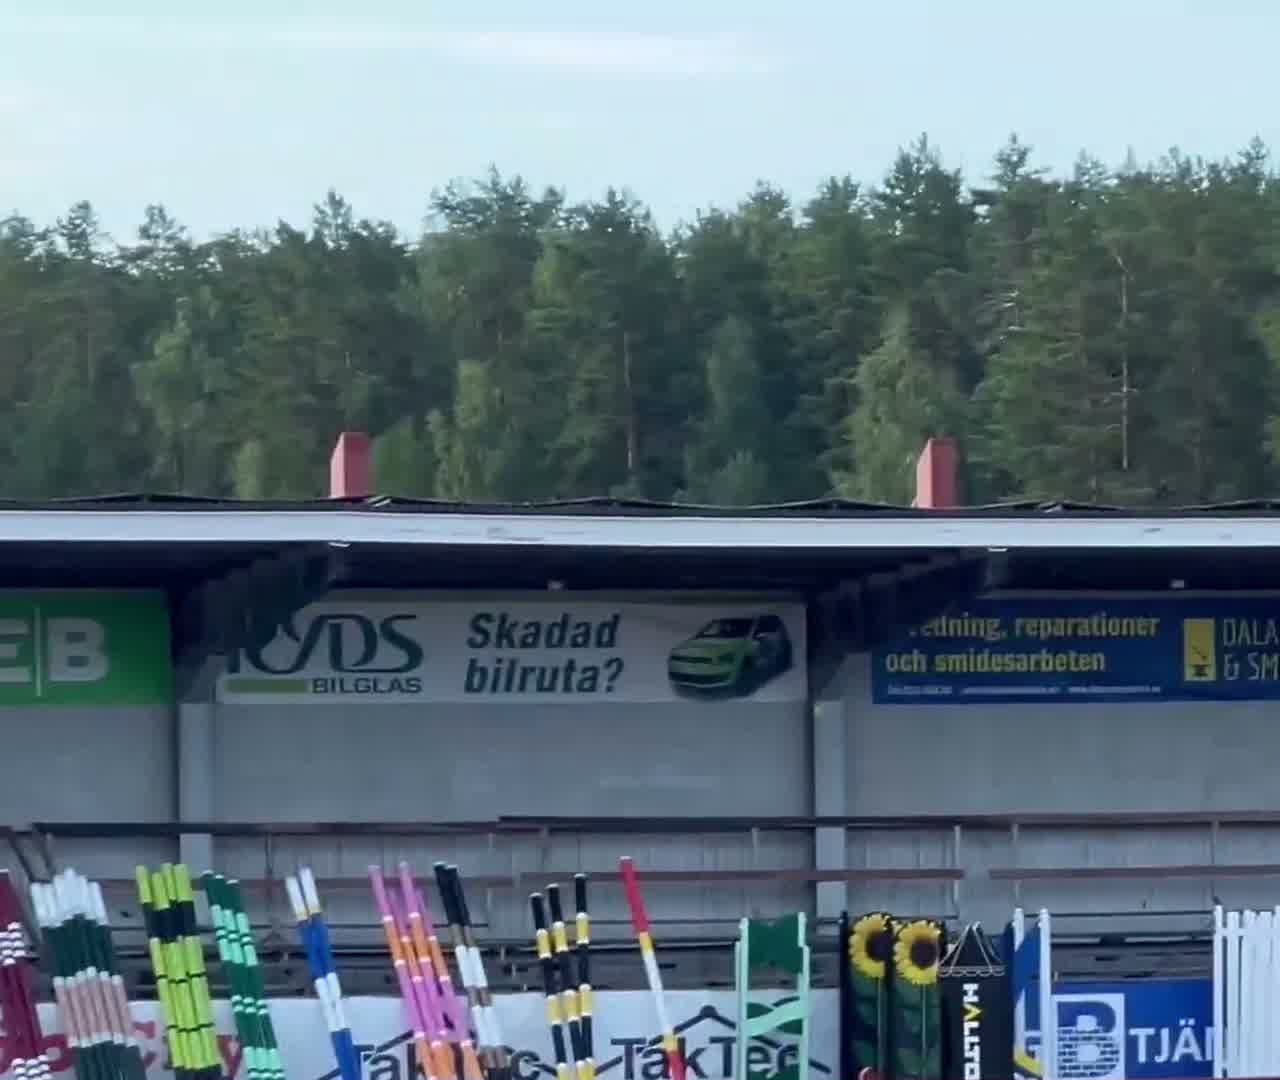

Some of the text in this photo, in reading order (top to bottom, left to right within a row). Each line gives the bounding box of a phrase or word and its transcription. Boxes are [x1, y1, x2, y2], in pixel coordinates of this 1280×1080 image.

[466, 612, 621, 649] Skadad
[1014, 613, 1161, 640] reparationer
[1223, 617, 1279, 647] DALA
[886, 649, 1105, 673] och smidesarbeten
[1223, 654, 1240, 680] &
[311, 677, 422, 694] BILGLAS
[464, 656, 625, 694] bilruta?
